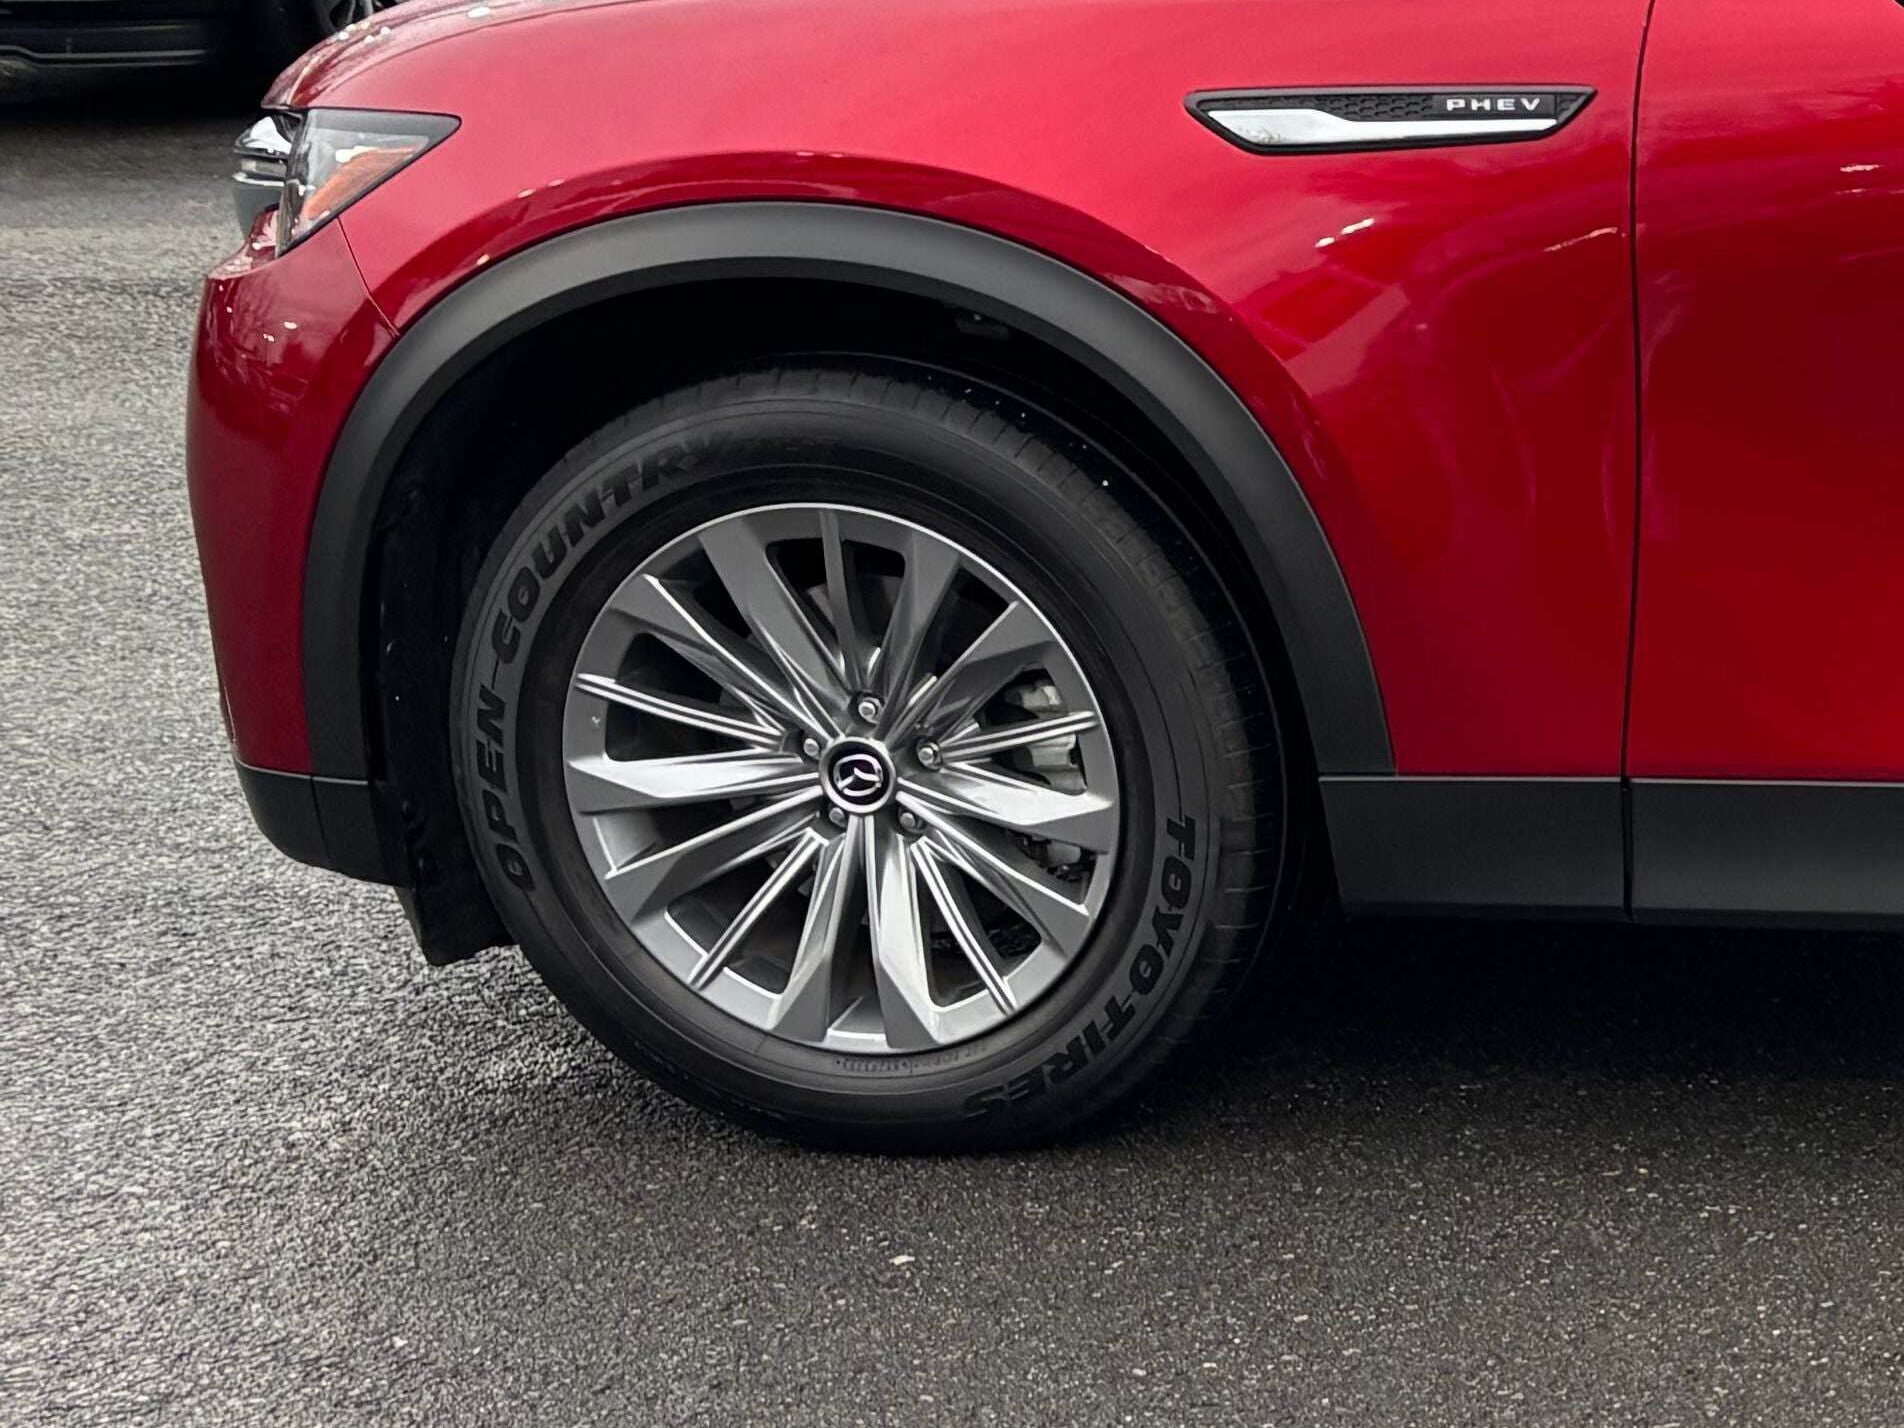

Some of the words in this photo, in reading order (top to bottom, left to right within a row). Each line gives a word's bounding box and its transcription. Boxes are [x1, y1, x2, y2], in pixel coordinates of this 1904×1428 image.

[1446, 97, 1541, 112] PHEV
[491, 429, 730, 664] COUNTRY
[471, 683, 535, 894] OPEN
[1131, 813, 1198, 993] TOYO
